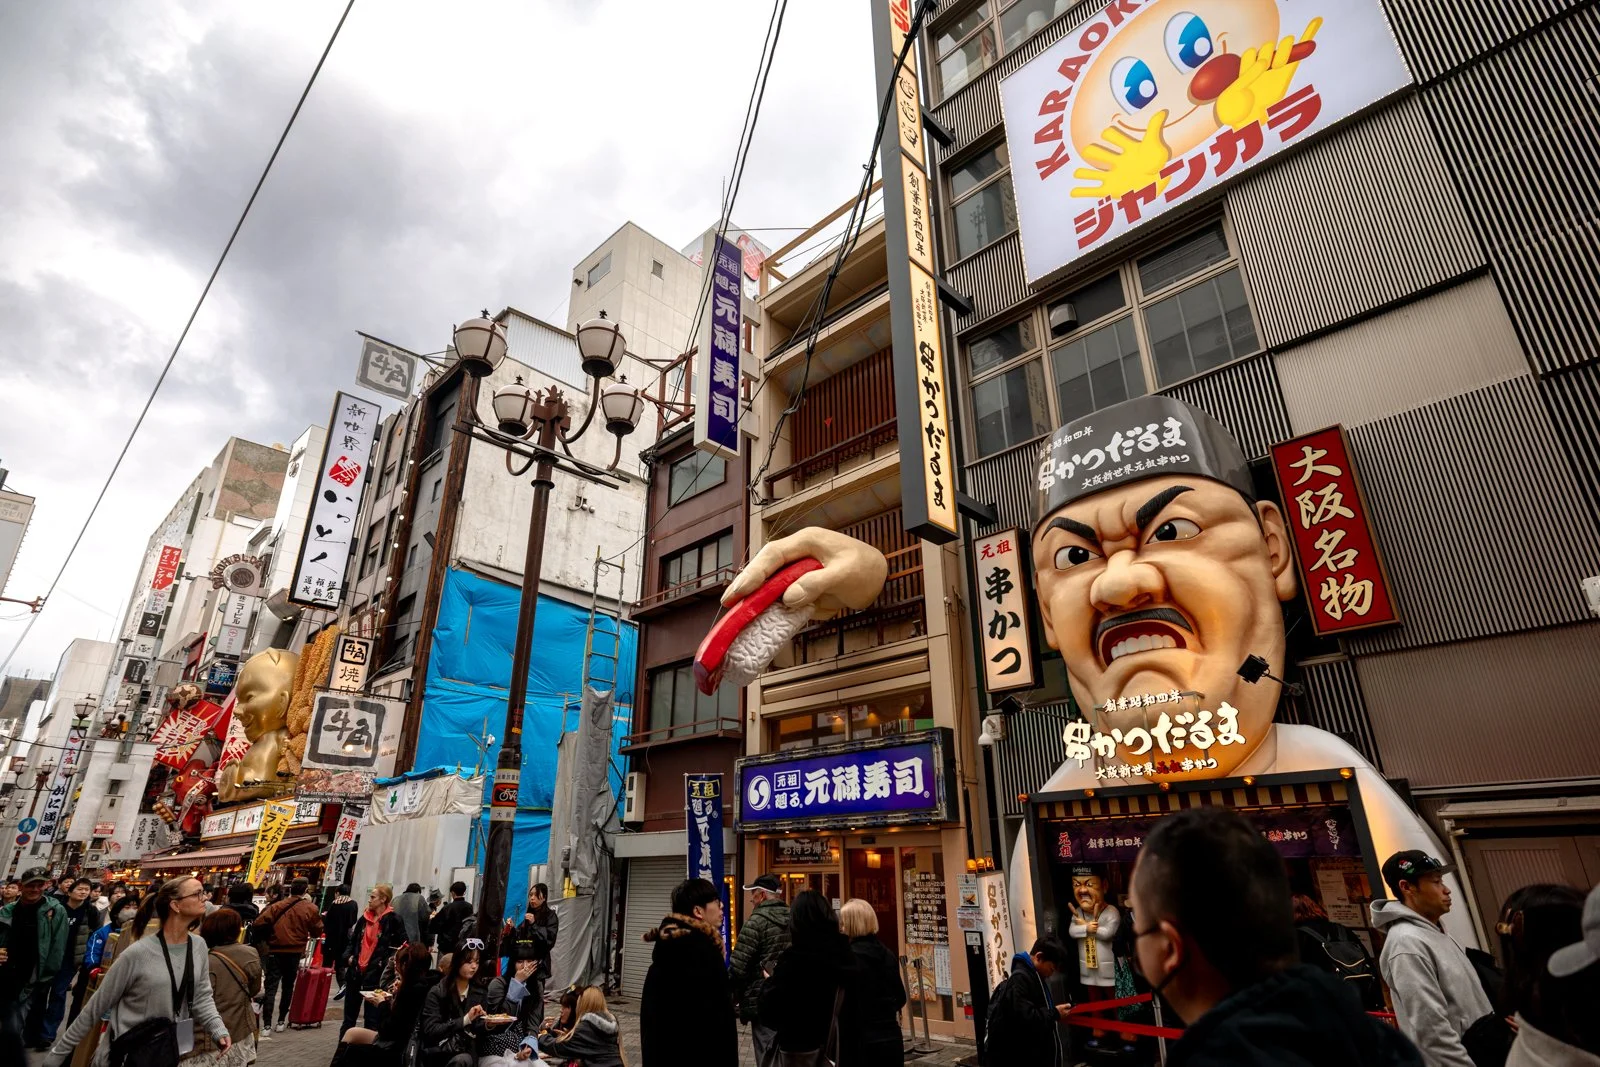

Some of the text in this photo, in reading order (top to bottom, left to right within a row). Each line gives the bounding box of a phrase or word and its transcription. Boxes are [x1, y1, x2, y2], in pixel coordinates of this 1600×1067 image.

[1034, 0, 1151, 181] KARAOK
[1072, 83, 1322, 250] ジャンカラ
[908, 171, 926, 257] 創業昭和四年
[716, 252, 740, 276] 元祖
[715, 271, 740, 295] 廻る
[370, 352, 408, 389] 牛角
[712, 293, 739, 424] 元禄寿司
[340, 403, 370, 452] 新世界
[918, 340, 946, 510] 串かつだるま
[1038, 416, 1188, 494] 串かつだるま
[1040, 425, 1094, 460] 創業昭和四年
[1081, 454, 1190, 490] 大阪新世界元祖串かつ
[1290, 444, 1374, 622] 大阪名物
[170, 550, 181, 567] ダーツ
[980, 538, 1013, 561] 元祖
[302, 586, 335, 600] 戎橋店
[303, 575, 337, 588] 道頓堀
[983, 566, 1023, 676] 串かつ
[345, 642, 365, 662] 牛角
[208, 679, 233, 687] OCEAN
[1102, 689, 1182, 713] 創業昭和四年
[323, 709, 373, 753] 牛角
[1062, 701, 1246, 769] 串かつだるま
[776, 772, 798, 788] 元祖
[803, 757, 925, 806] 元禄寿司
[1094, 757, 1219, 780] 大阪新世界元祖串かつ
[691, 782, 716, 797] 元祖
[774, 791, 801, 809] 廻る
[38, 785, 67, 837] かに道楽
[691, 798, 714, 816] 廻る
[261, 812, 277, 843] ランチ
[267, 818, 289, 852] こだわり
[1086, 836, 1143, 849] 創業昭和四年
[1058, 832, 1073, 858] 元祖
